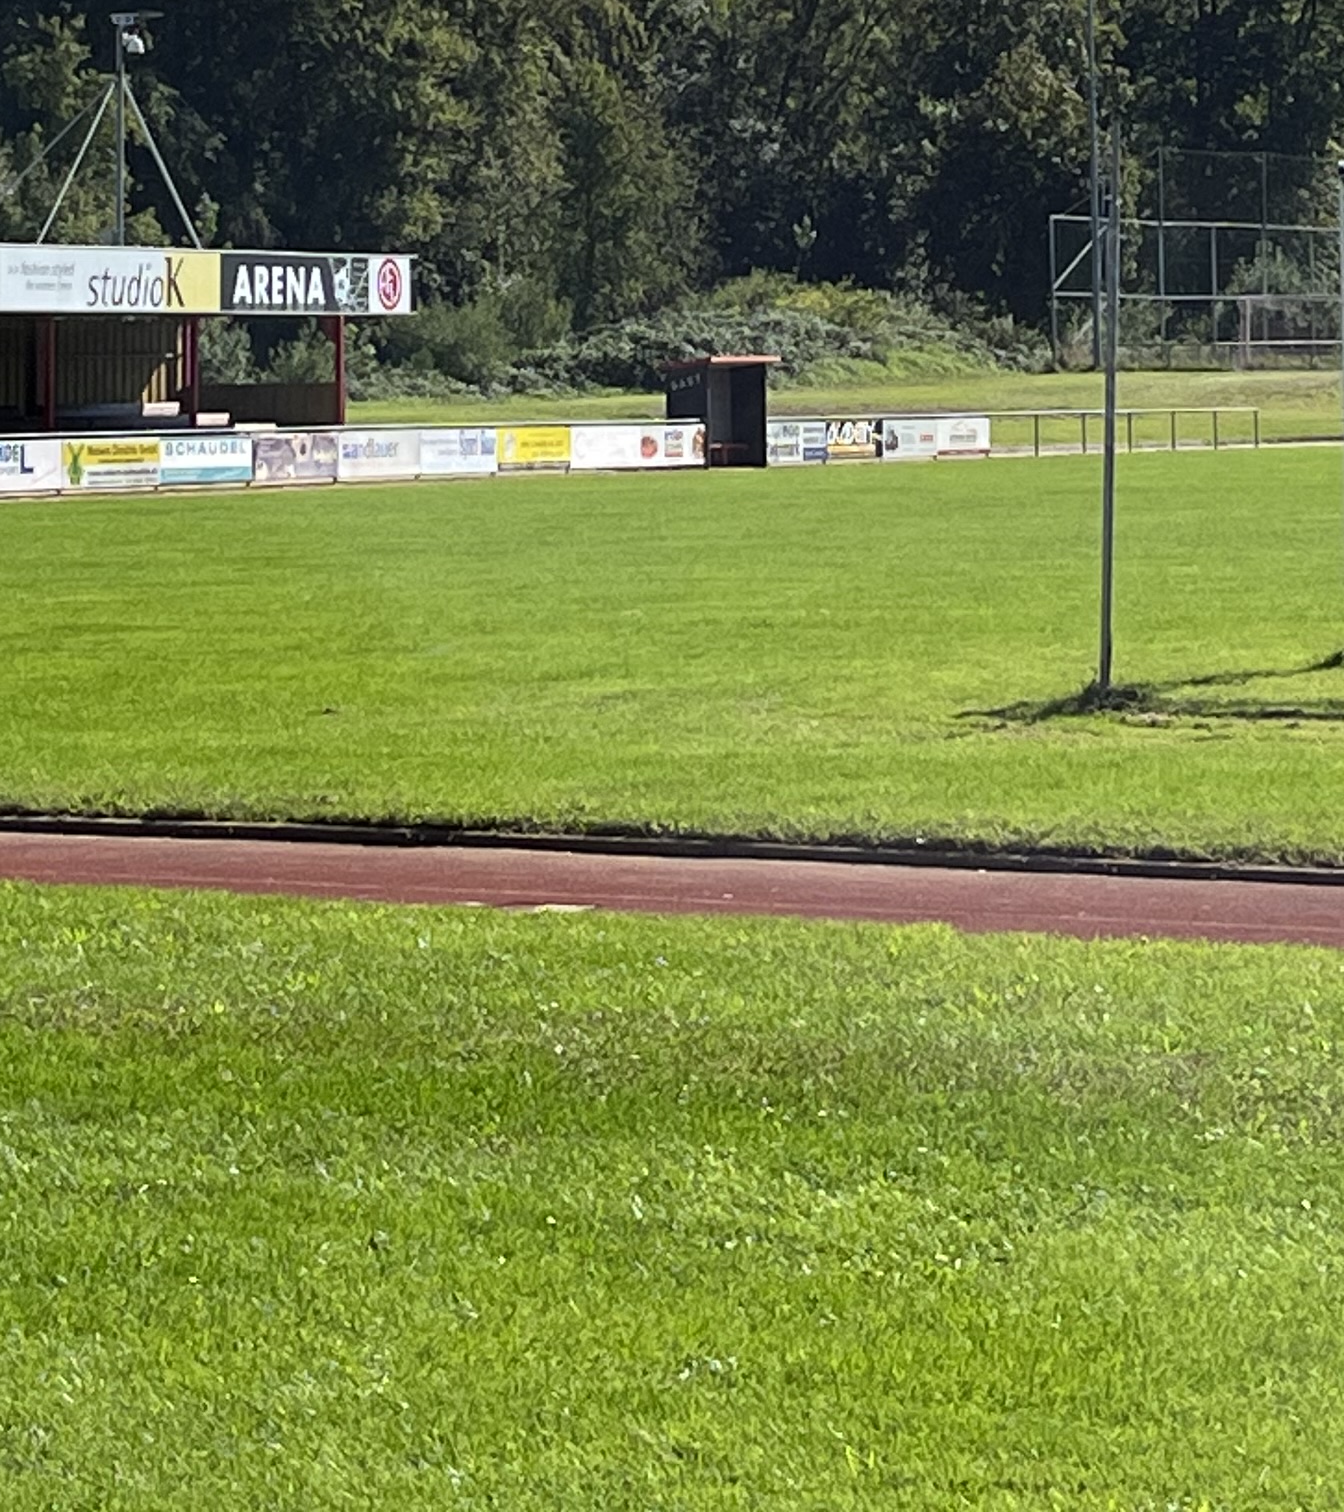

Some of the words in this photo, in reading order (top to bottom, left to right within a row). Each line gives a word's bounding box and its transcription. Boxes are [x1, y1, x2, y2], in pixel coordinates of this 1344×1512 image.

[86, 256, 185, 307] studioK
[232, 264, 326, 304] ARENA
[165, 441, 247, 456] SCHAUDEL
